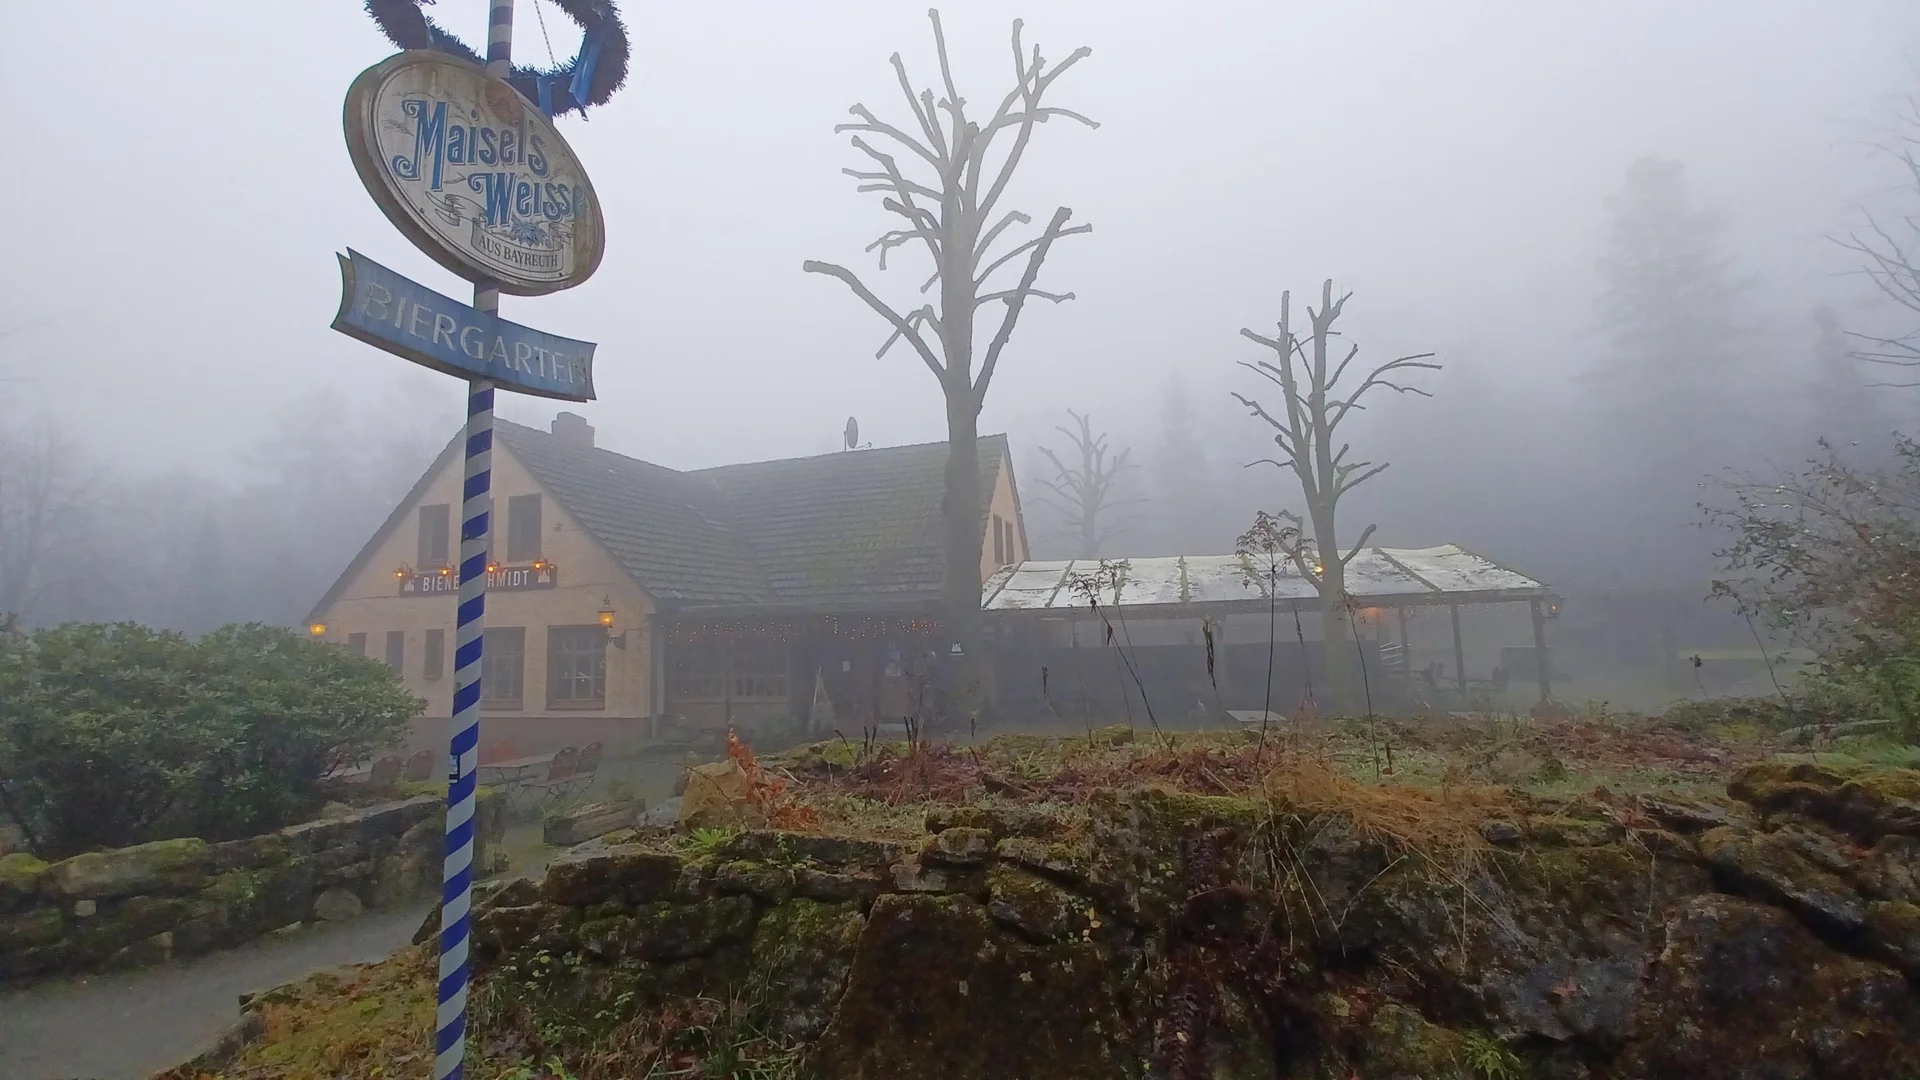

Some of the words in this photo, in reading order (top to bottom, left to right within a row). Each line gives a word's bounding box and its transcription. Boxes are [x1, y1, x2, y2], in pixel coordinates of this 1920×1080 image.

[392, 99, 549, 192] Maisel's
[480, 234, 501, 257] AUS
[503, 245, 558, 267] BAYREUTH
[361, 283, 587, 384] BIERGARTEN
